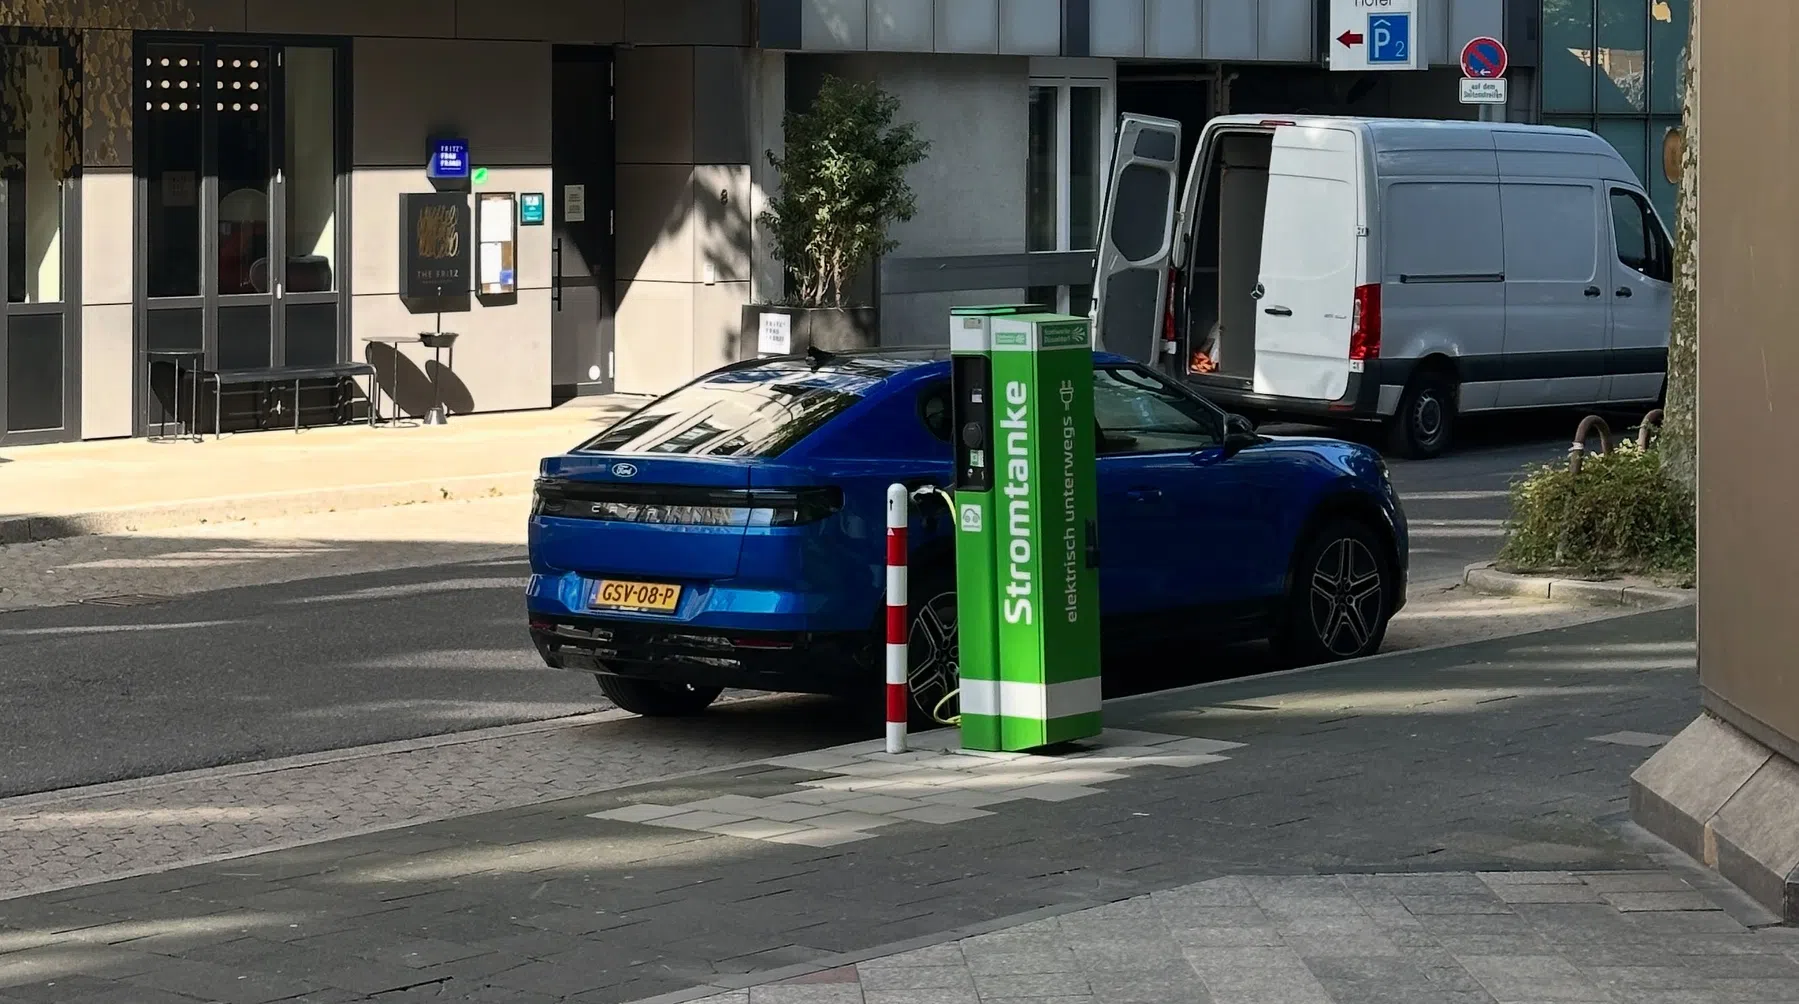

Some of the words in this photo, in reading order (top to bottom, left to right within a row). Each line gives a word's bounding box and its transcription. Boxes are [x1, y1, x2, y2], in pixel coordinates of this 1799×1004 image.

[417, 270, 432, 278] THE
[436, 269, 459, 278] FRITZ
[1000, 380, 1033, 625] Stromtanke
[1063, 416, 1076, 522] unterwegs
[602, 583, 674, 605] GSV-08-P
[1063, 527, 1078, 623] elektrisch
